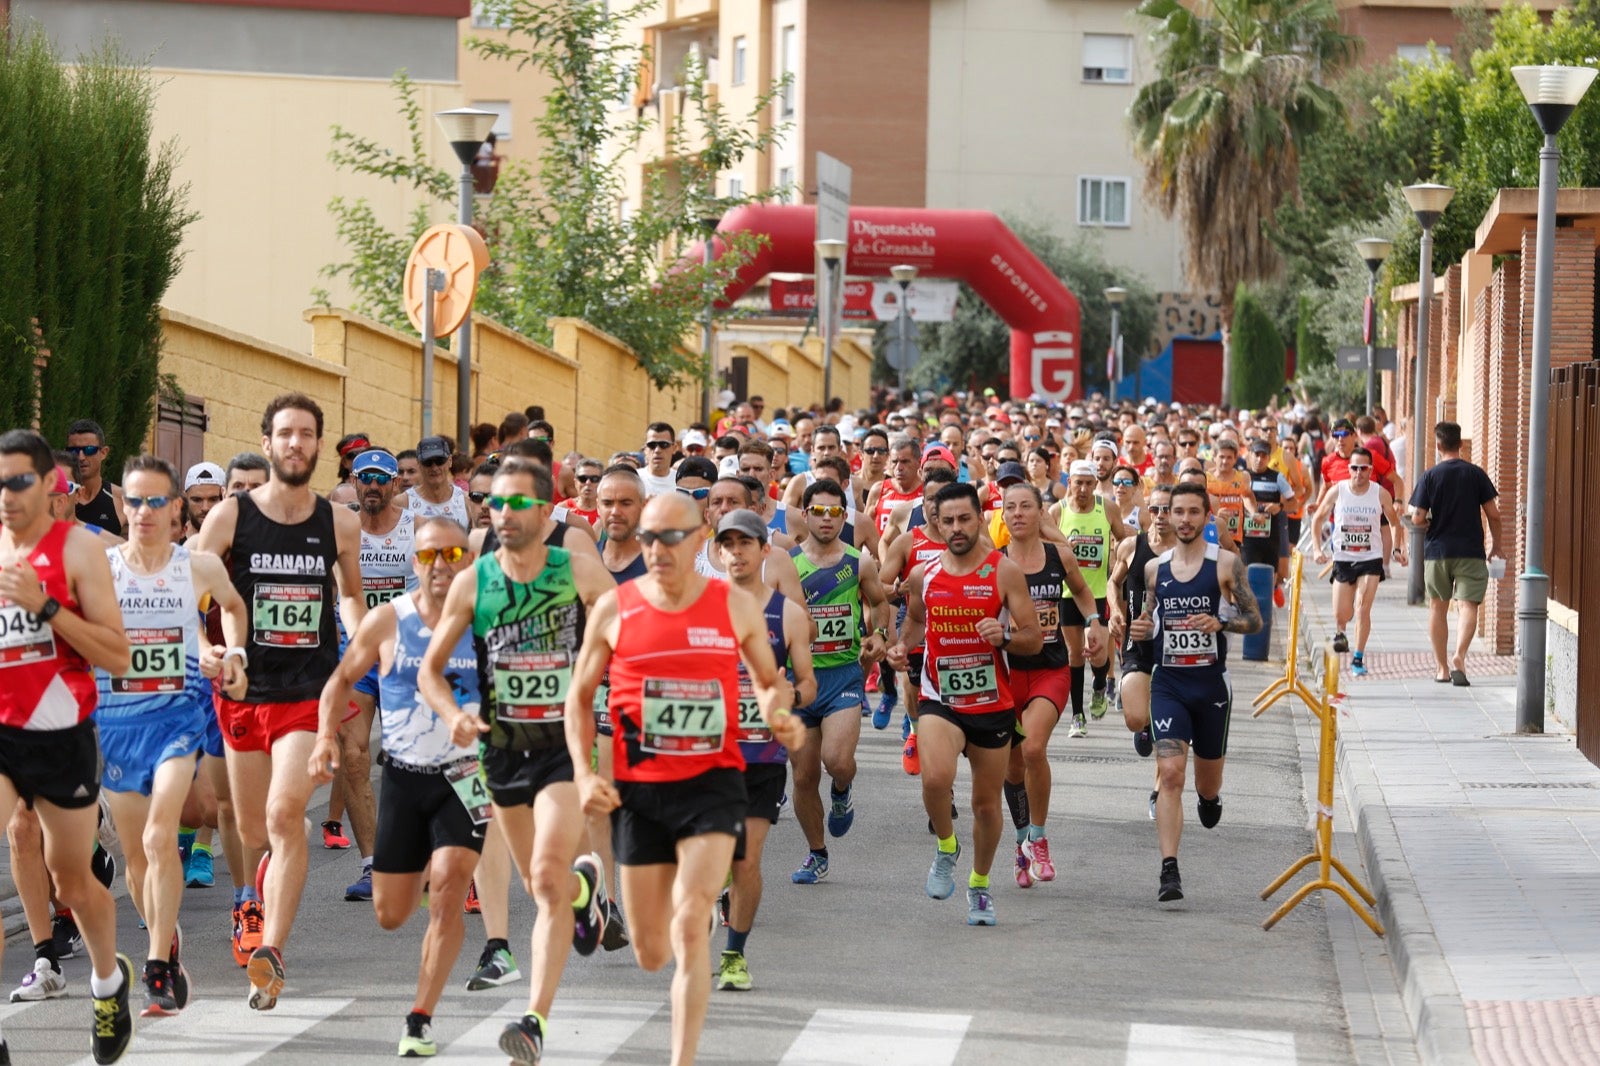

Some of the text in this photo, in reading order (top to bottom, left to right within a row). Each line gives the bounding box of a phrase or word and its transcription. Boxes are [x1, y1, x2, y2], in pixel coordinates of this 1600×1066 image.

[853, 220, 935, 238] Diputación
[852, 238, 935, 256] de Granada
[991, 254, 1048, 313] DEPORTES
[783, 294, 800, 305] DE
[1344, 533, 1370, 543] 3062
[359, 552, 406, 562] ARACENA
[1073, 545, 1098, 558] 459
[250, 553, 326, 570] GRANADA
[1029, 584, 1061, 596] NADA
[1163, 596, 1210, 609] BEWOR
[268, 604, 312, 626] 164
[1039, 610, 1057, 627] 56
[931, 621, 975, 632] Polisal
[1169, 632, 1212, 649] 3033
[508, 675, 560, 699] 929
[948, 669, 988, 691] 635
[657, 704, 714, 729] 477
